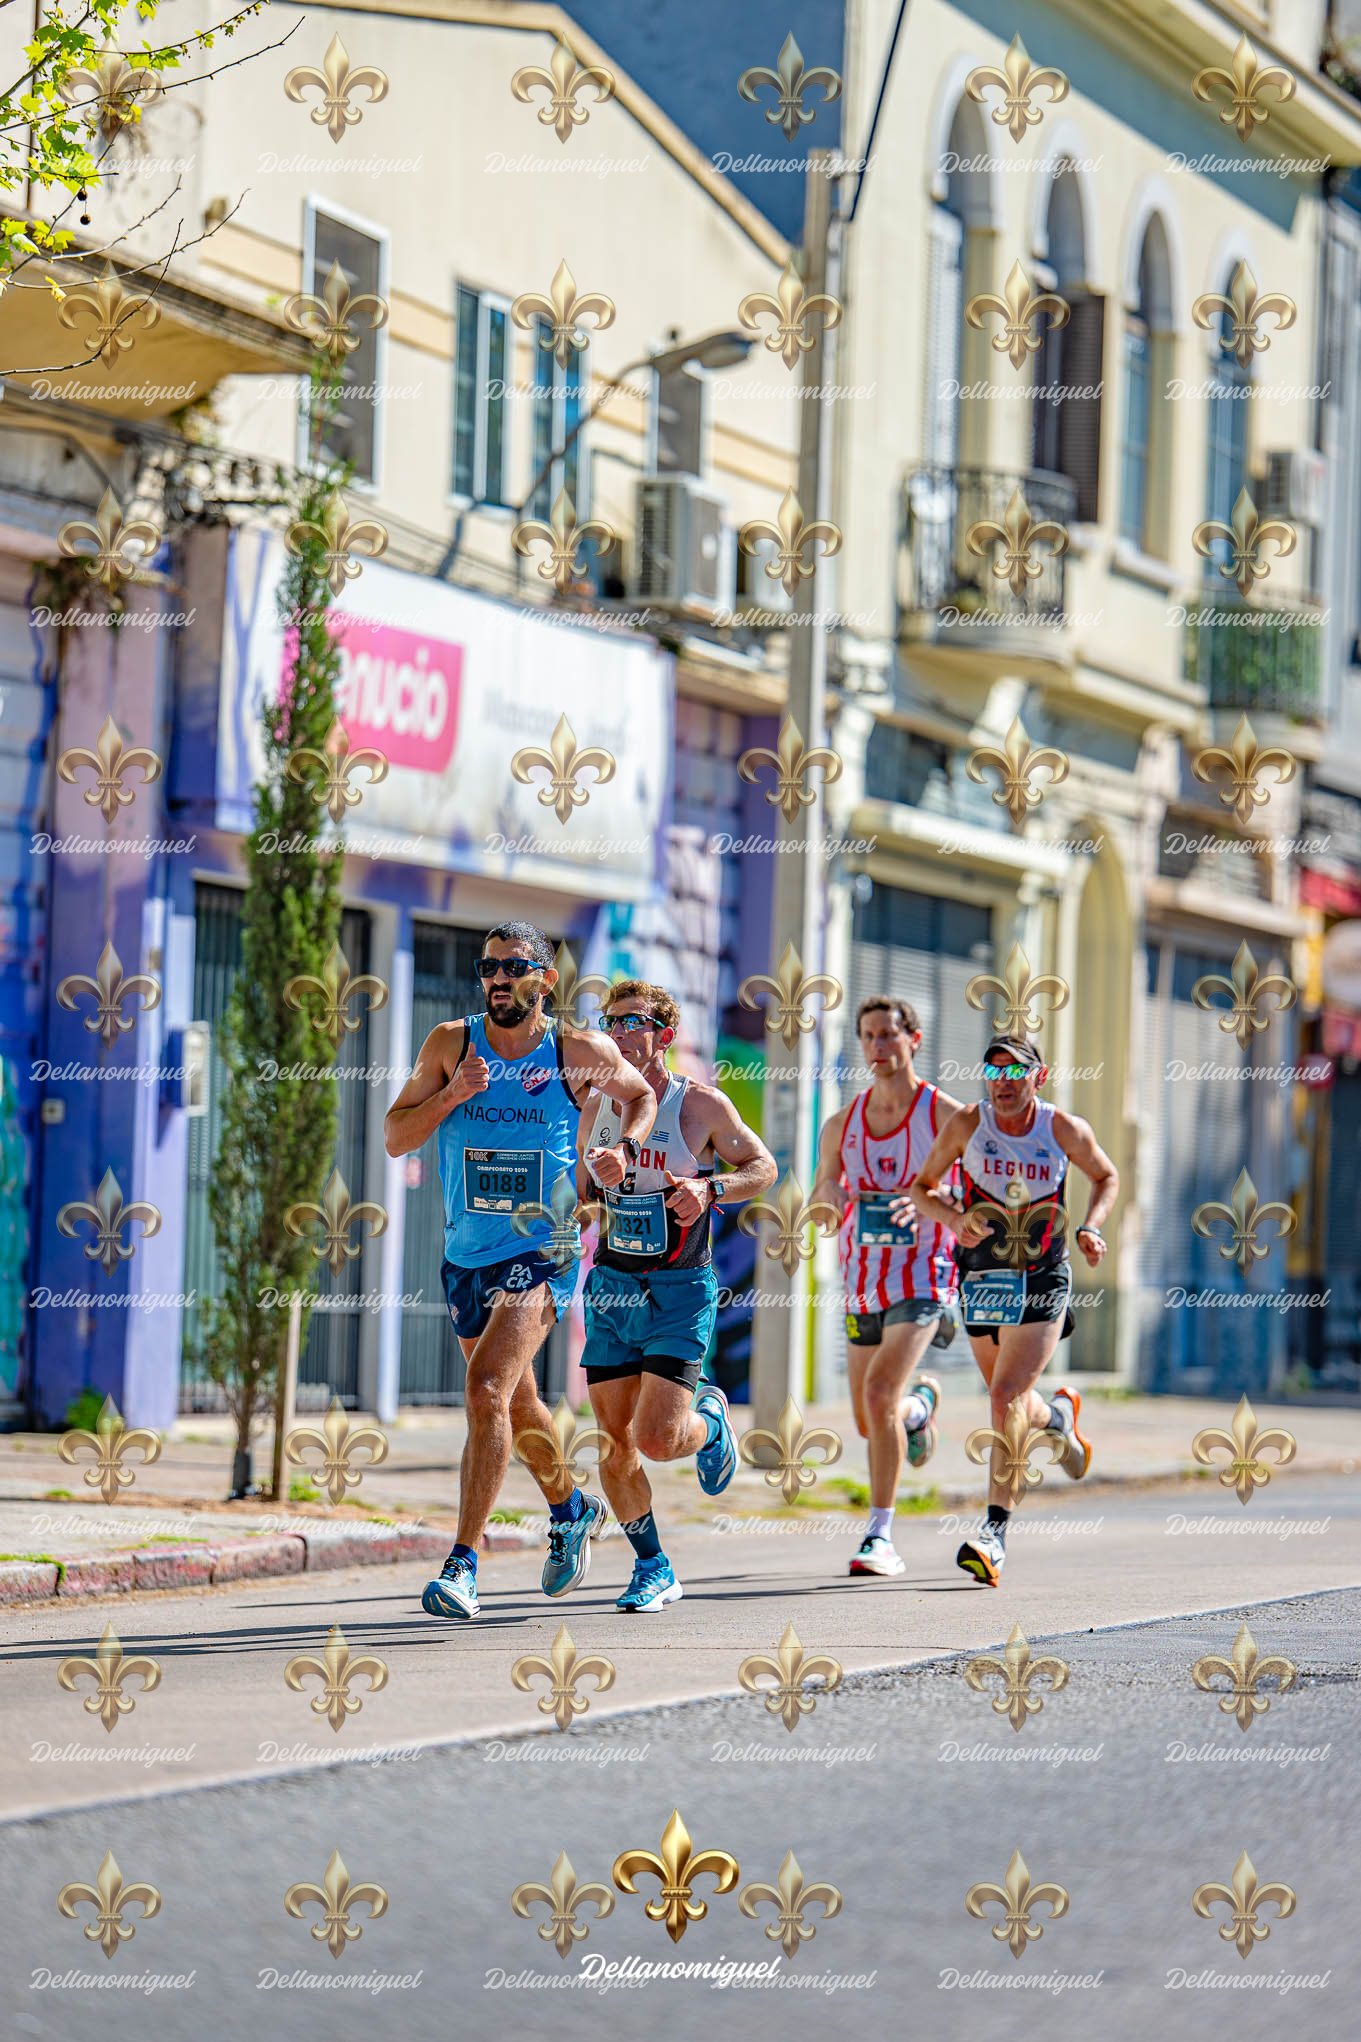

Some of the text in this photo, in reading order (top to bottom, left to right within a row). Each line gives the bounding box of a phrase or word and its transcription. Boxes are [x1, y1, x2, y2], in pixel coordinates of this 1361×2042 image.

[463, 1104, 547, 1125] NACIONAL
[468, 1150, 489, 1162] 10K
[983, 1158, 1050, 1181] LEGION
[479, 1173, 527, 1193] 0188
[615, 1215, 652, 1235] 0321
